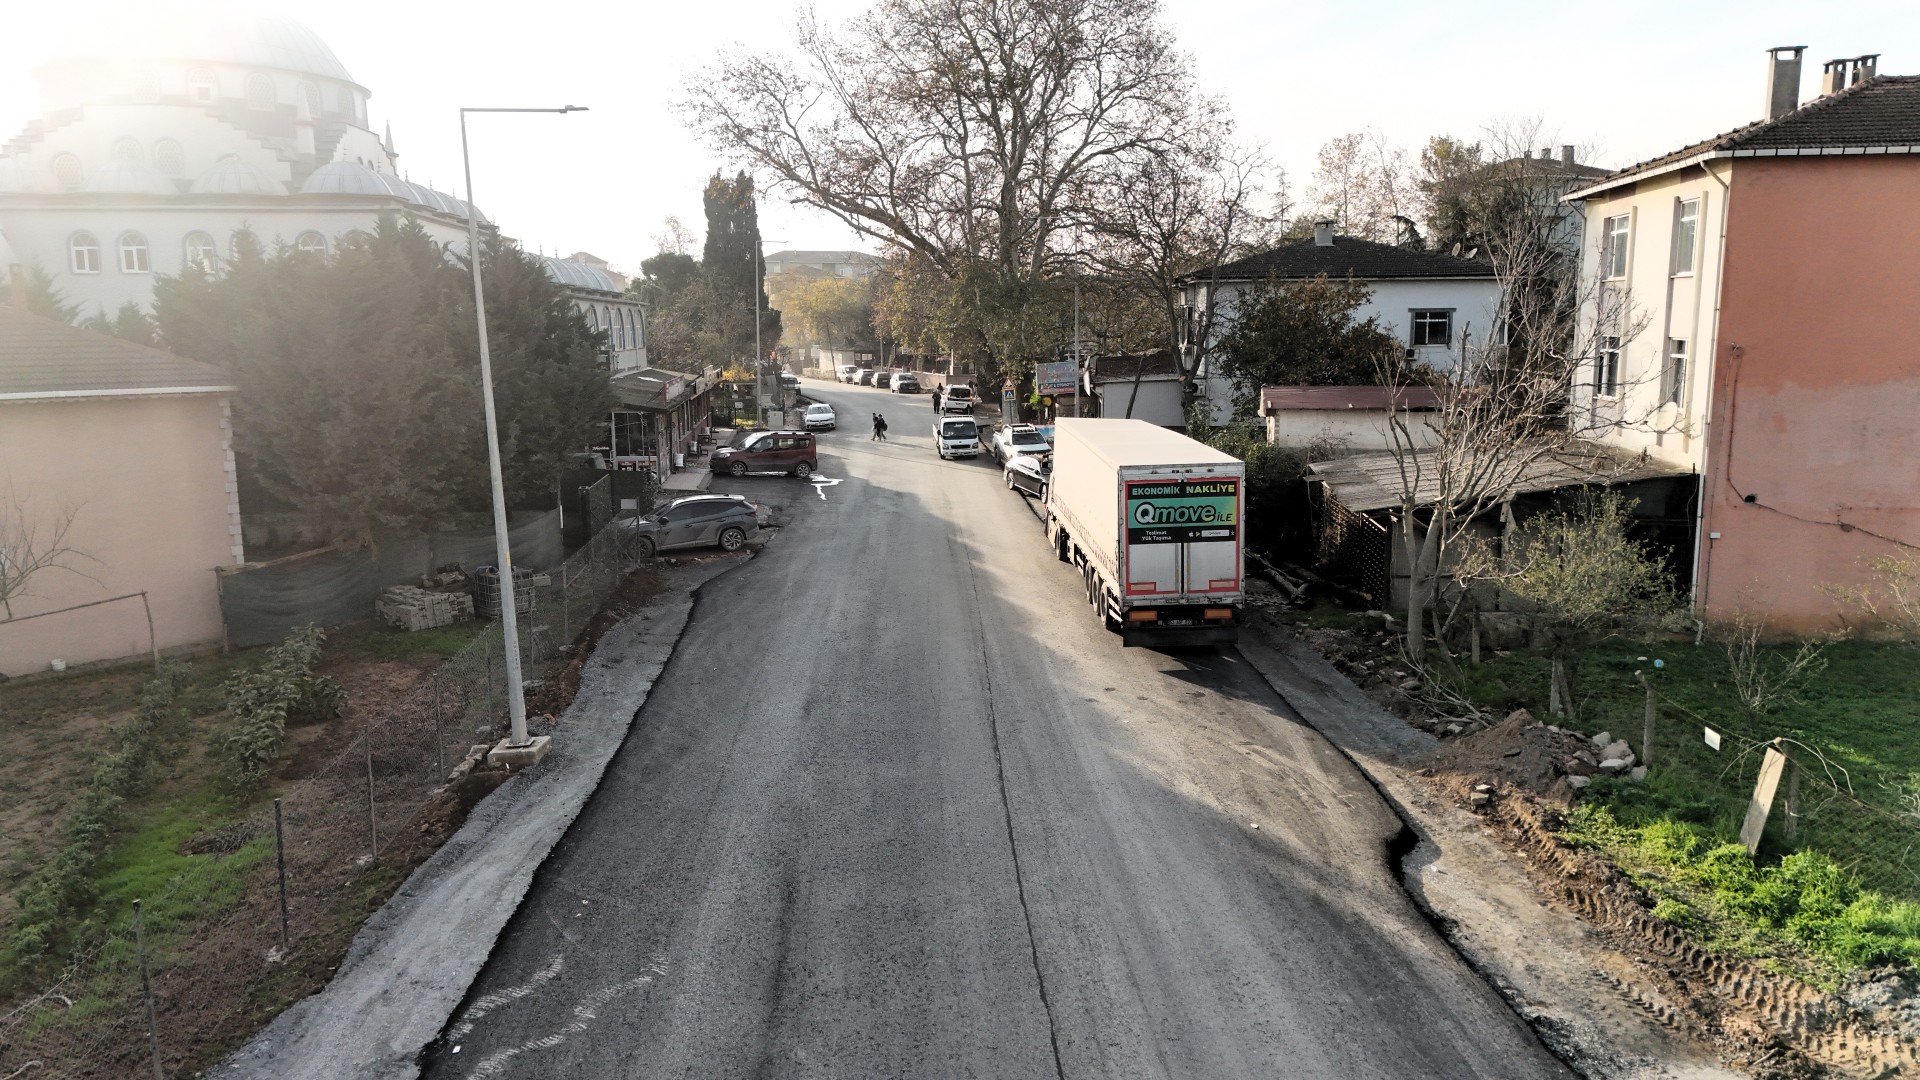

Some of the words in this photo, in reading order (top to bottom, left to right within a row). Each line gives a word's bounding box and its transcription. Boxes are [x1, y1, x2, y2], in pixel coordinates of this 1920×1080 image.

[1132, 486, 1180, 495] EKONOMİK
[1186, 484, 1235, 493] NAKLİYE
[1135, 502, 1216, 525] Qmove
[1217, 512, 1232, 521] İLE
